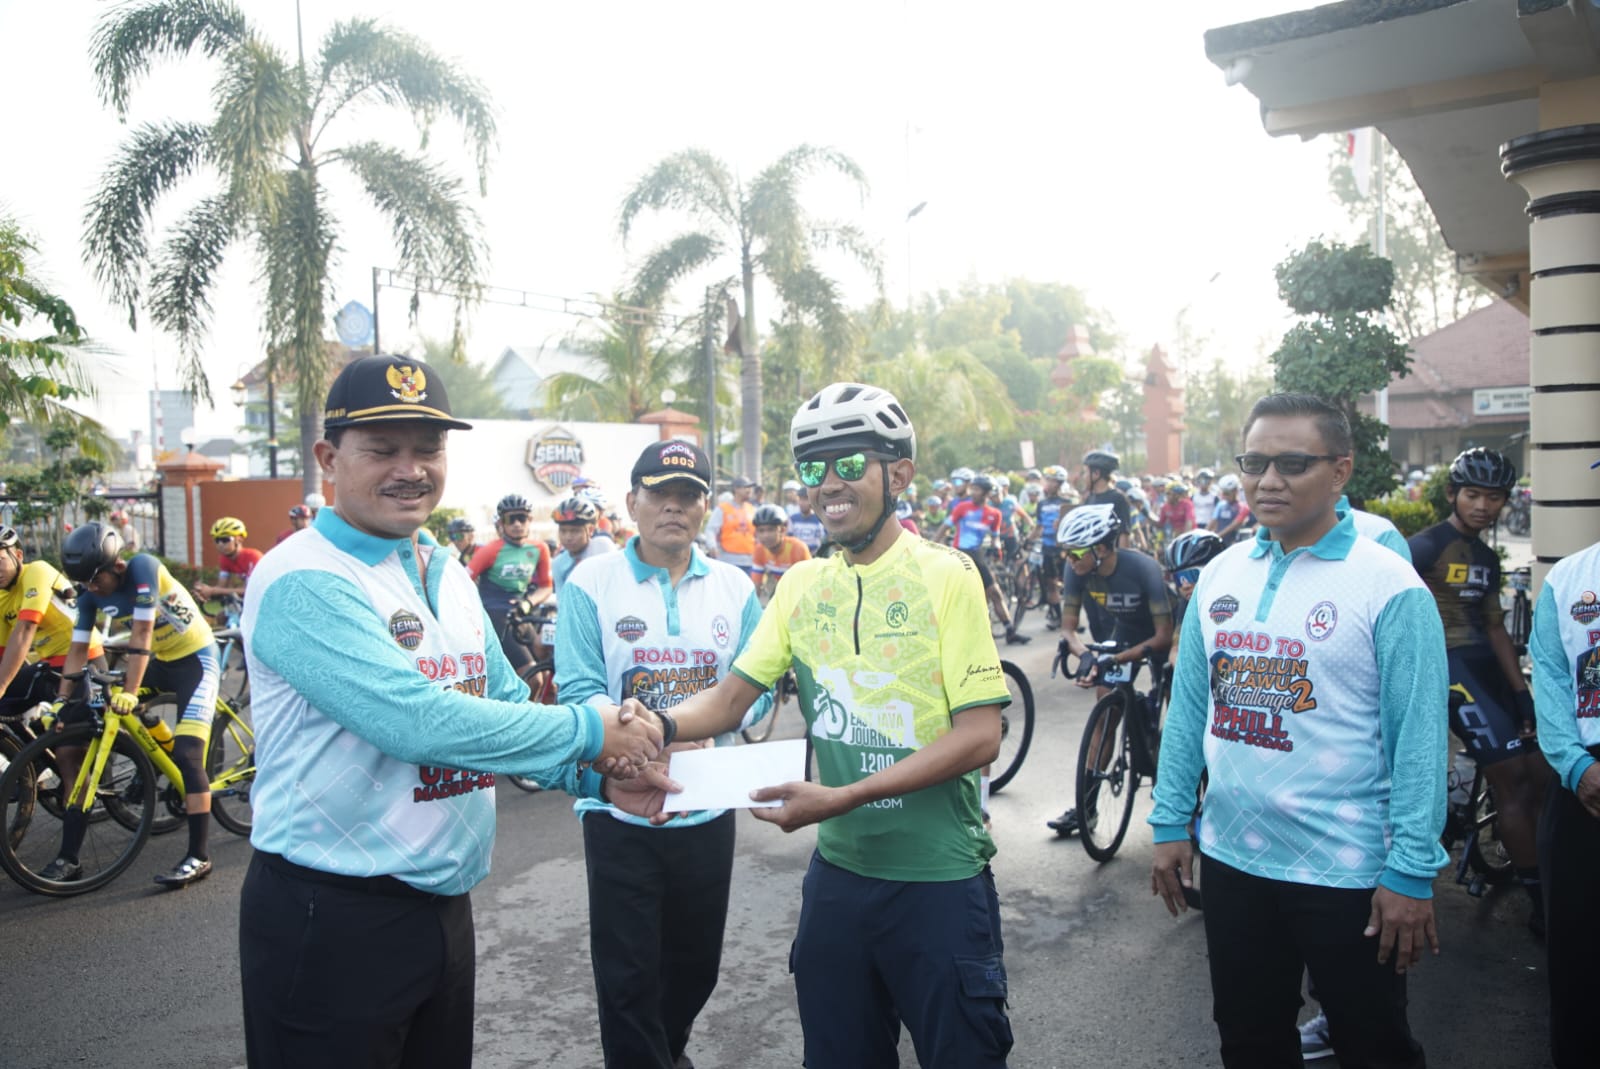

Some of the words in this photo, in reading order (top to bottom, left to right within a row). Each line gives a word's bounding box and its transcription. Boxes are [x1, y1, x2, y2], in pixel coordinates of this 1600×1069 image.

[535, 445, 582, 464] SEHAT
[663, 457, 694, 469] 0803
[1215, 631, 1271, 653] ROAD
[1275, 636, 1305, 659] TO
[460, 652, 486, 677] TO
[632, 648, 687, 665] ROAD
[692, 649, 717, 665] TO
[1231, 656, 1308, 677] MADIUN
[652, 664, 718, 683] MADIUN
[1234, 672, 1292, 691] LAWU
[1225, 685, 1295, 715] Challenge
[1288, 678, 1317, 714] 2
[1214, 703, 1289, 739] UPHILL
[860, 751, 895, 773] 1200
